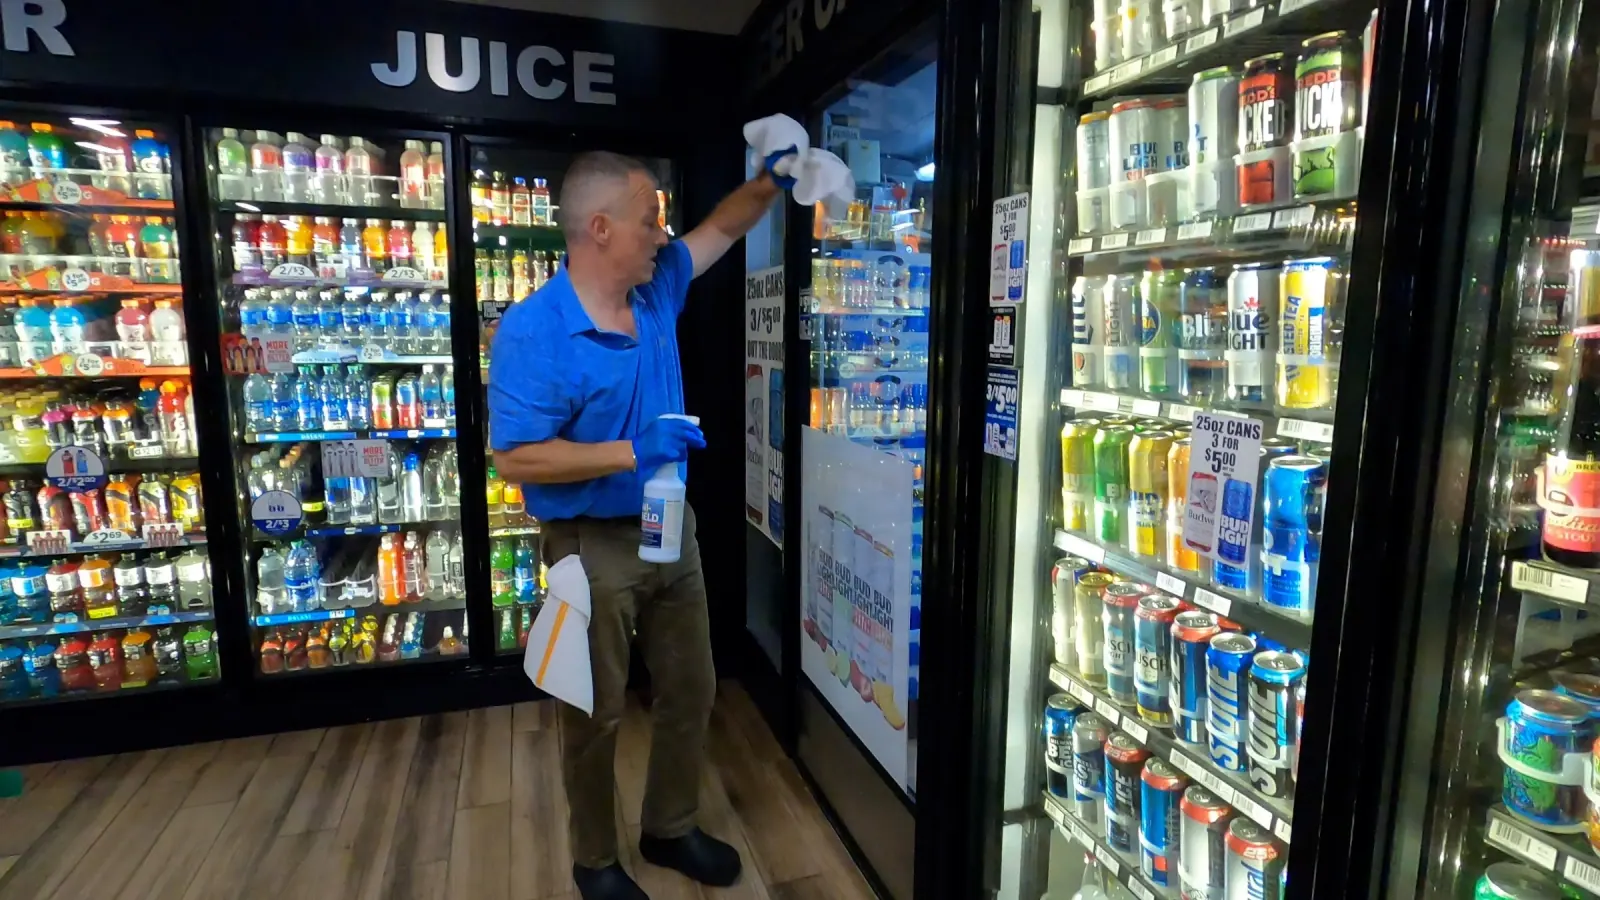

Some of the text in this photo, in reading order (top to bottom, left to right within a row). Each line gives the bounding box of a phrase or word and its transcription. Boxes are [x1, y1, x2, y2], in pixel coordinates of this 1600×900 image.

[370, 30, 617, 105] JUICE
[280, 266, 305, 276] 2/$3
[391, 269, 415, 279] 2/$3
[1196, 415, 1261, 440] 25oz CANS
[1211, 433, 1239, 451] 3 FOR
[265, 519, 290, 529] 2/$3
[1220, 514, 1249, 533] BUD
[835, 560, 851, 584] BUD
[853, 574, 871, 598] BUD
[873, 590, 892, 614] BUD
